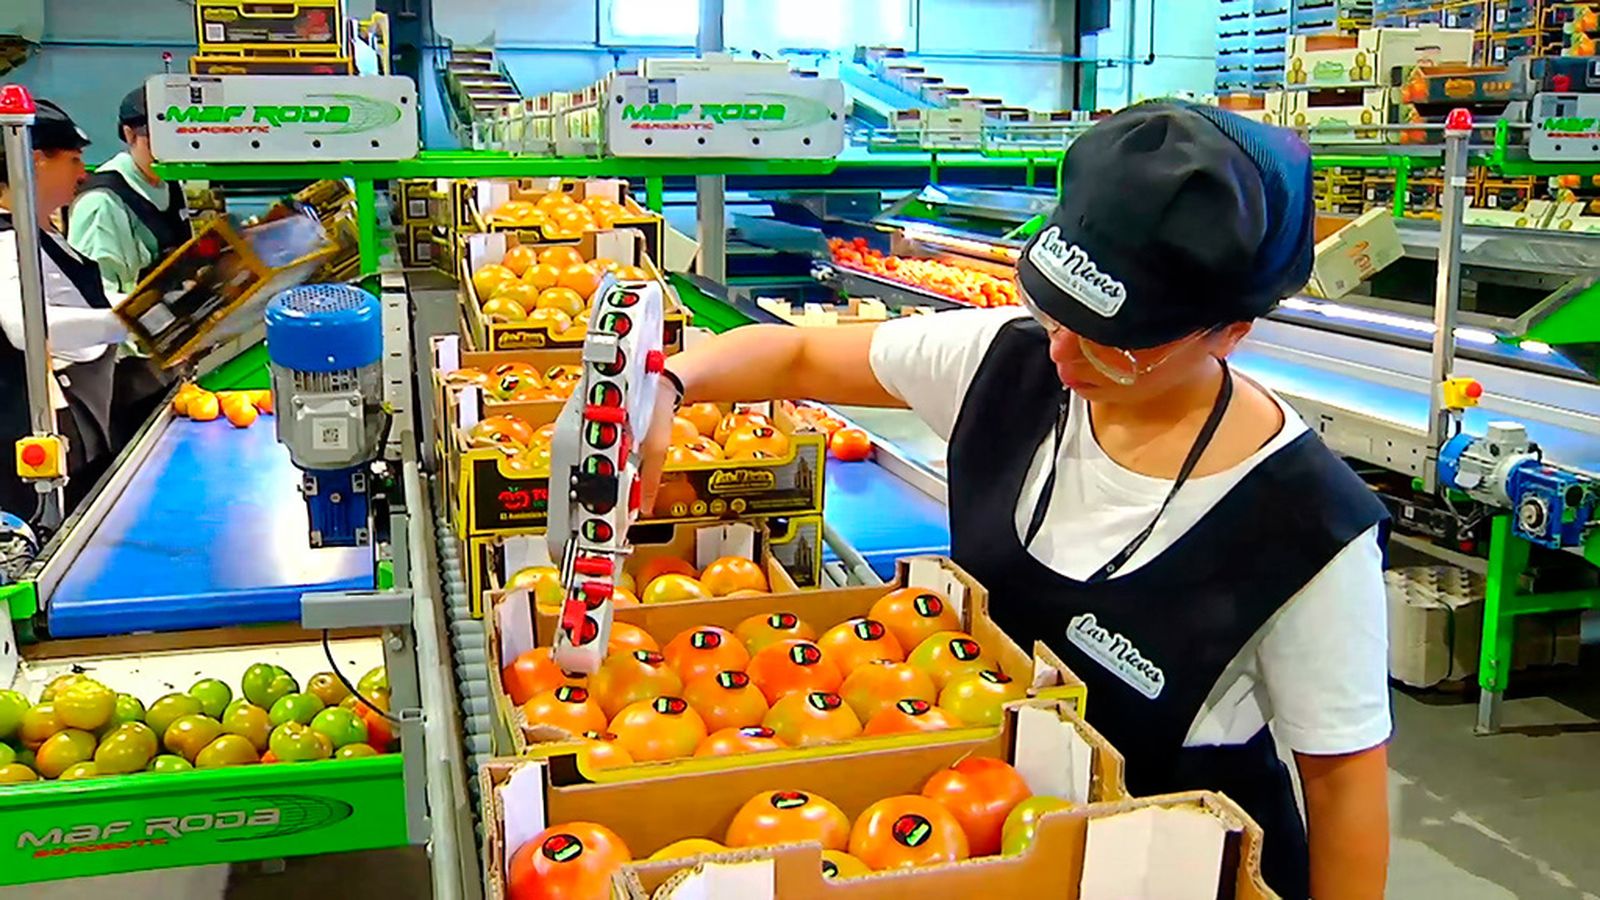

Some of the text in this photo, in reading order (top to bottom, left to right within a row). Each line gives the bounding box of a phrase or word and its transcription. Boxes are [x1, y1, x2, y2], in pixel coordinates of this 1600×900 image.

[1041, 230, 1063, 259] Las
[1063, 248, 1122, 298] Nieves
[1076, 616, 1106, 643] Las
[1109, 635, 1161, 683] Nieves
